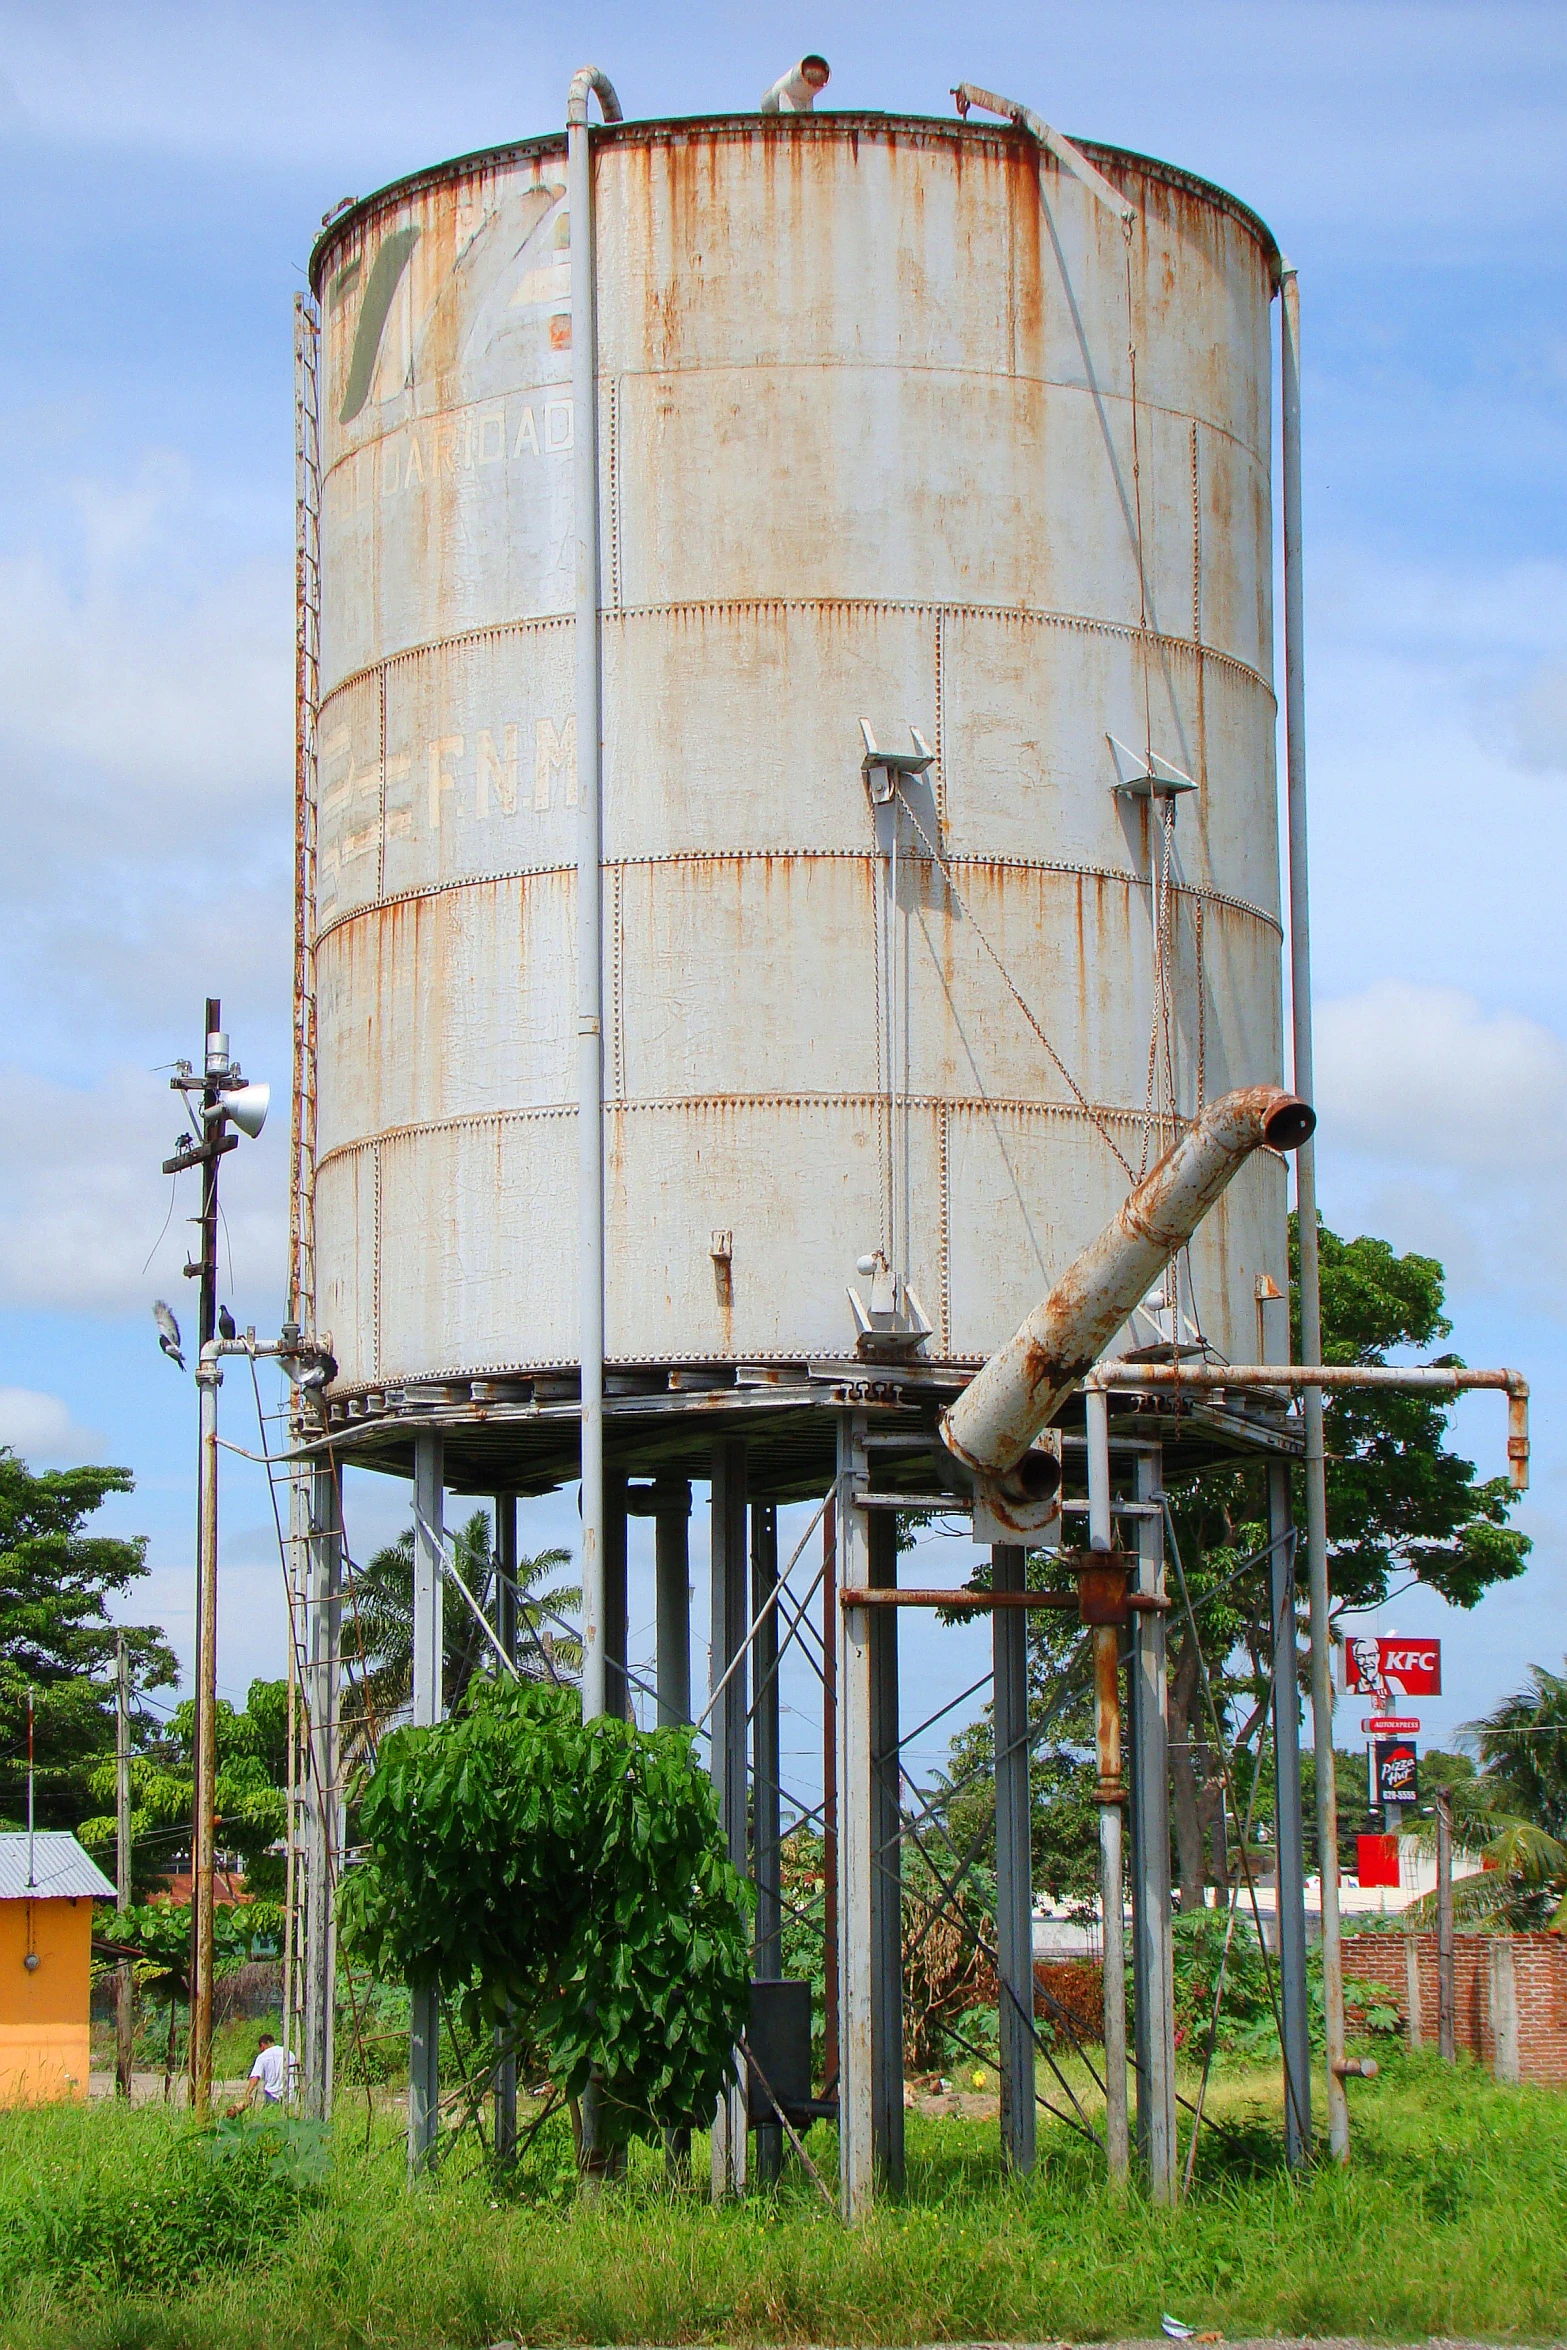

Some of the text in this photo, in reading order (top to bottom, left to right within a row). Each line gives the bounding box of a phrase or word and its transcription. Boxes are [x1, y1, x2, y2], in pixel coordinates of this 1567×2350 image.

[1384, 1651, 1435, 1671] KFC
[1374, 1721, 1419, 1729] AUTOEXPRESS
[1381, 1758, 1416, 1781] Pizza
[1387, 1769, 1412, 1786] Hut
